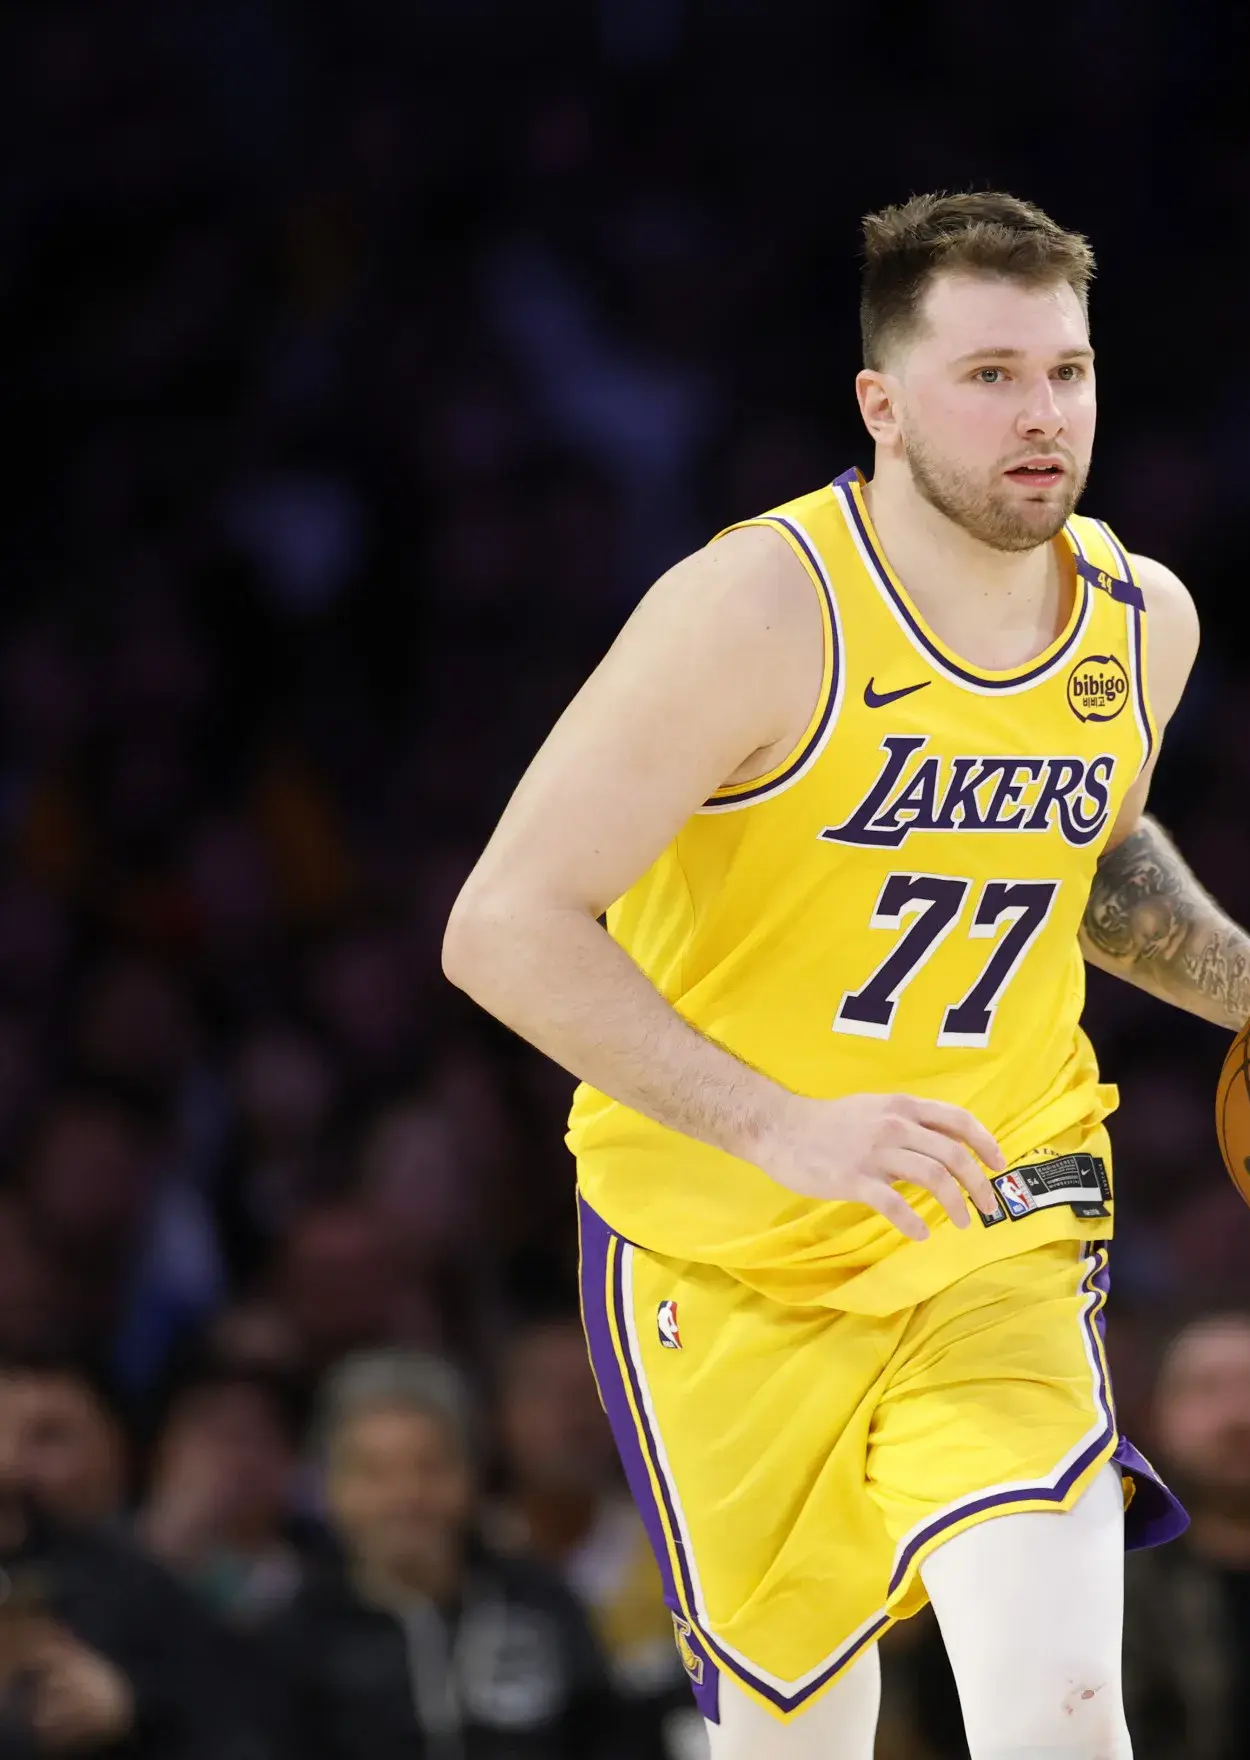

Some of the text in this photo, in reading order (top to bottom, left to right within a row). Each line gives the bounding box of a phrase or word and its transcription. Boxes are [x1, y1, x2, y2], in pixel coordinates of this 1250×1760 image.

[1097, 573, 1113, 595] 44
[1073, 673, 1125, 702] bibigo
[1082, 697, 1106, 708] 비비고
[816, 734, 1118, 849] LAKERS
[831, 871, 1063, 1048] 77
